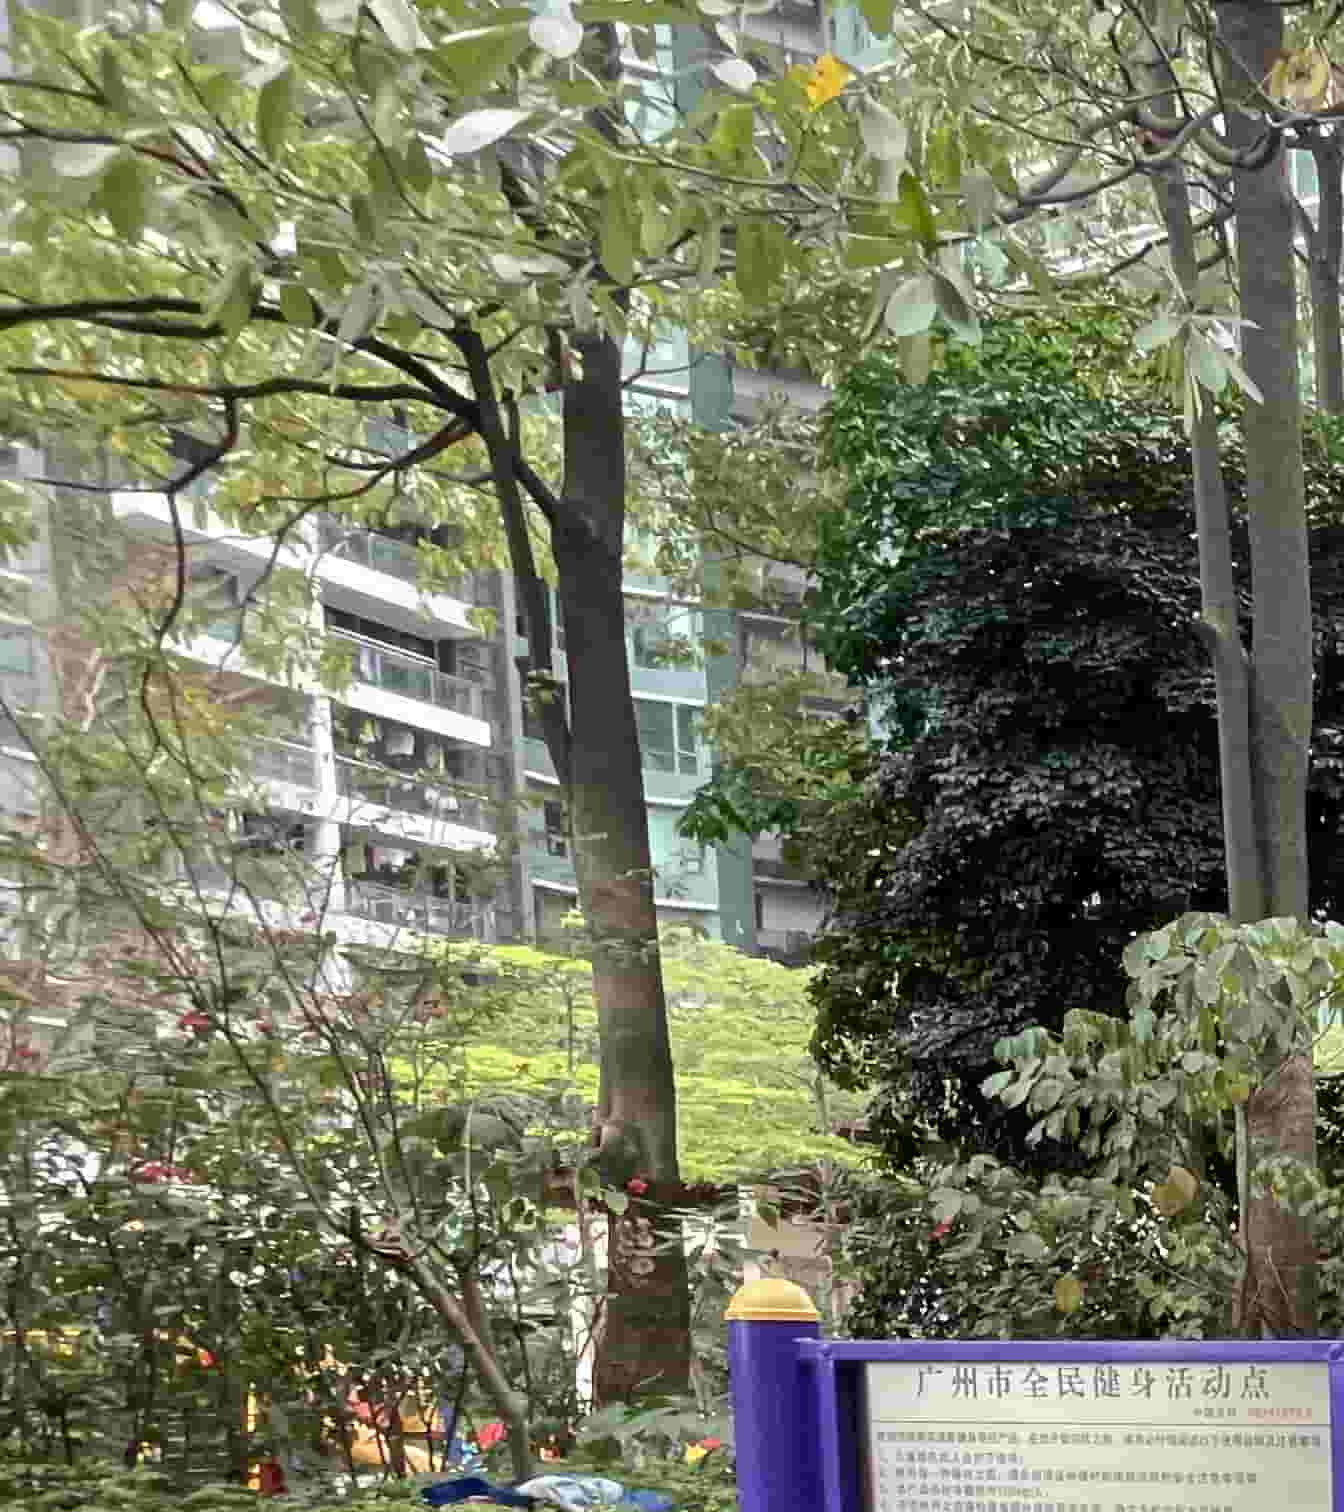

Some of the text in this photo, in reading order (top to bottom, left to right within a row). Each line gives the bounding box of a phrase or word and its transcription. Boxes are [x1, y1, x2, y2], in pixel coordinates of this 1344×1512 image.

[916, 1365, 1270, 1400] 广州市全民健身活动点
